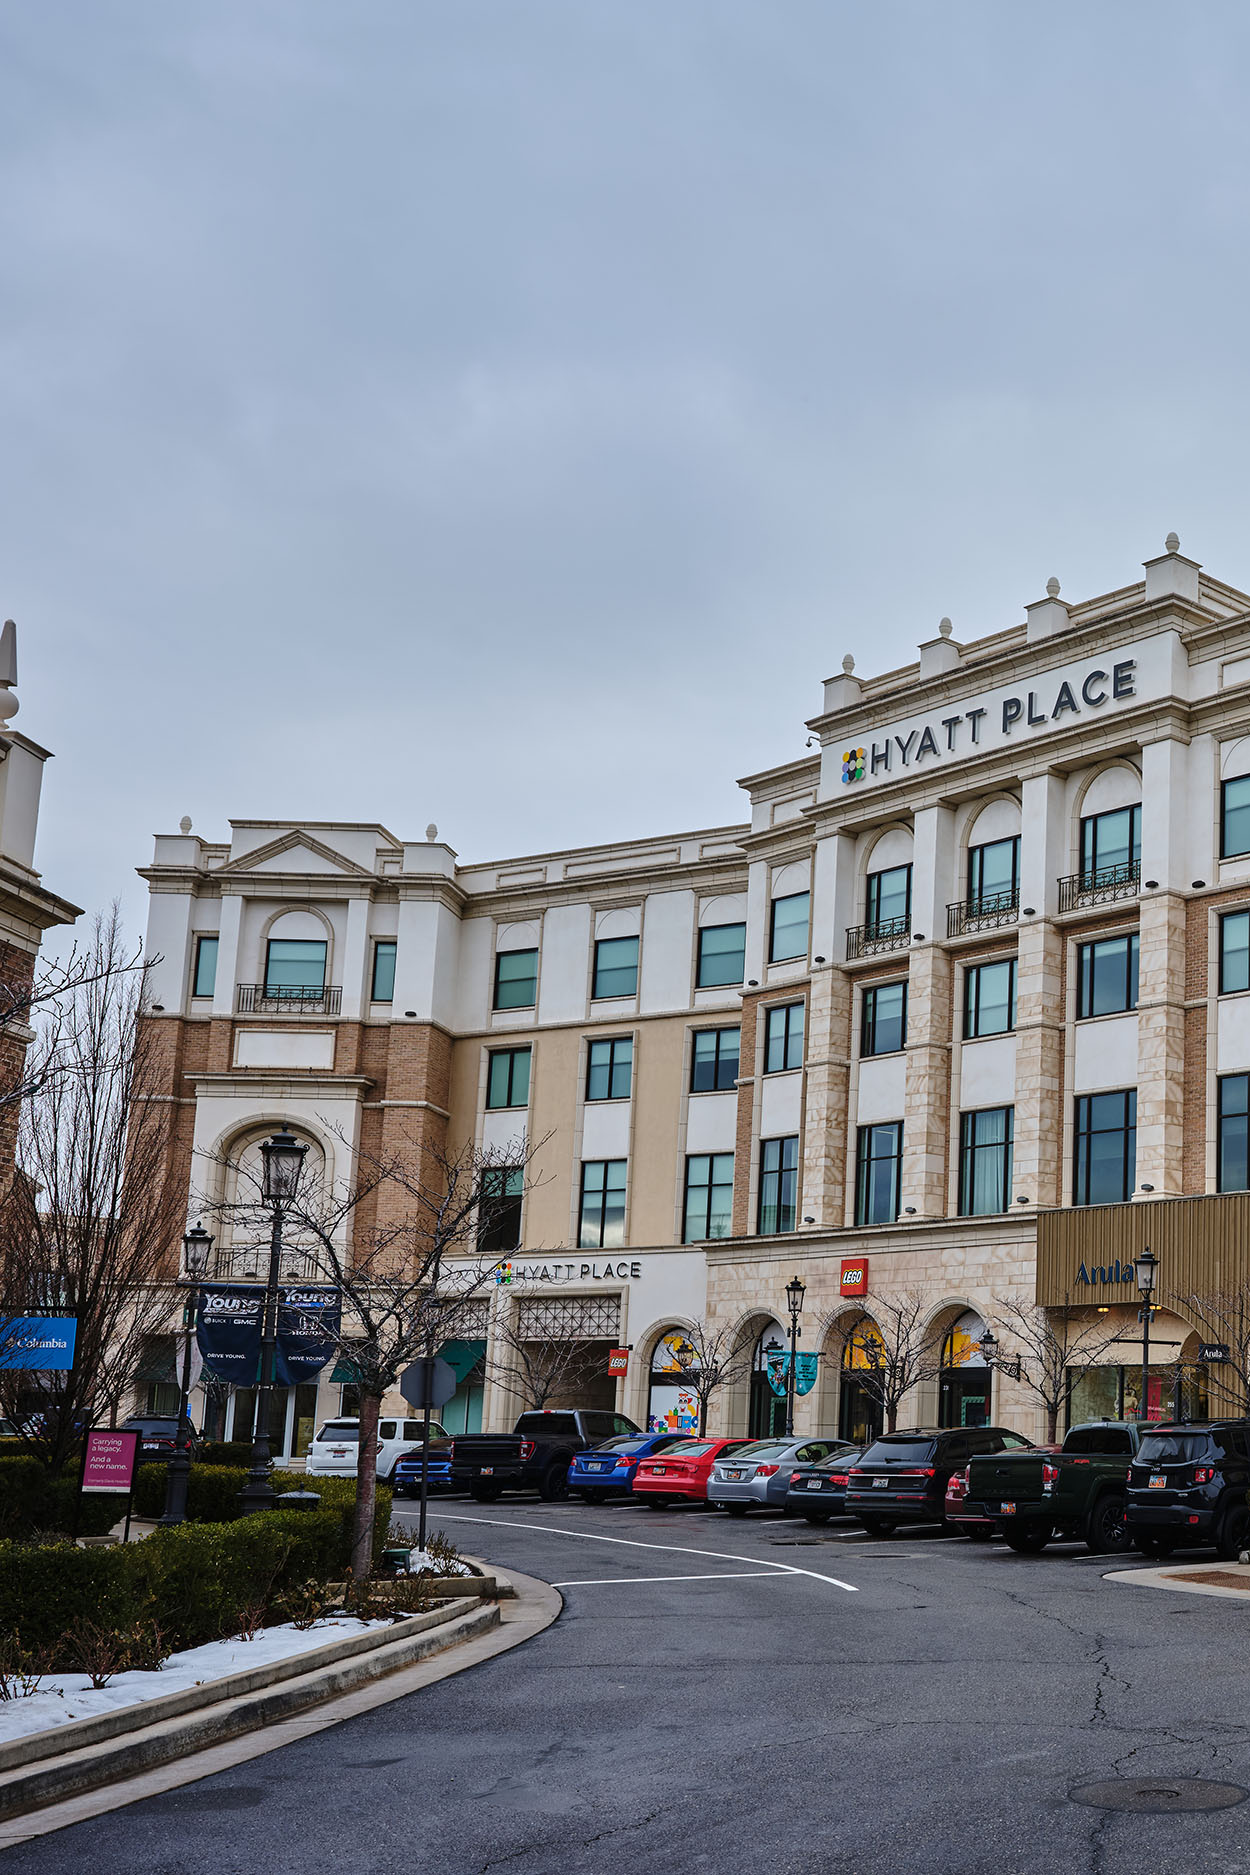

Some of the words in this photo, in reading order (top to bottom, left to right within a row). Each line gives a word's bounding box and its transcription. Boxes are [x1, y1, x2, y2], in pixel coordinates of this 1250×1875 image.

[870, 707, 987, 775] HYATT
[1001, 659, 1137, 734] PLACE
[515, 1264, 575, 1280] HYATT
[580, 1262, 642, 1278] PLACE
[842, 1269, 863, 1285] LEGO
[1075, 1259, 1134, 1285] Arula
[1203, 1349, 1223, 1358] Arula
[610, 1356, 627, 1368] LEGO
[92, 1438, 122, 1446] Carrying
[98, 1445, 122, 1453] legacy.
